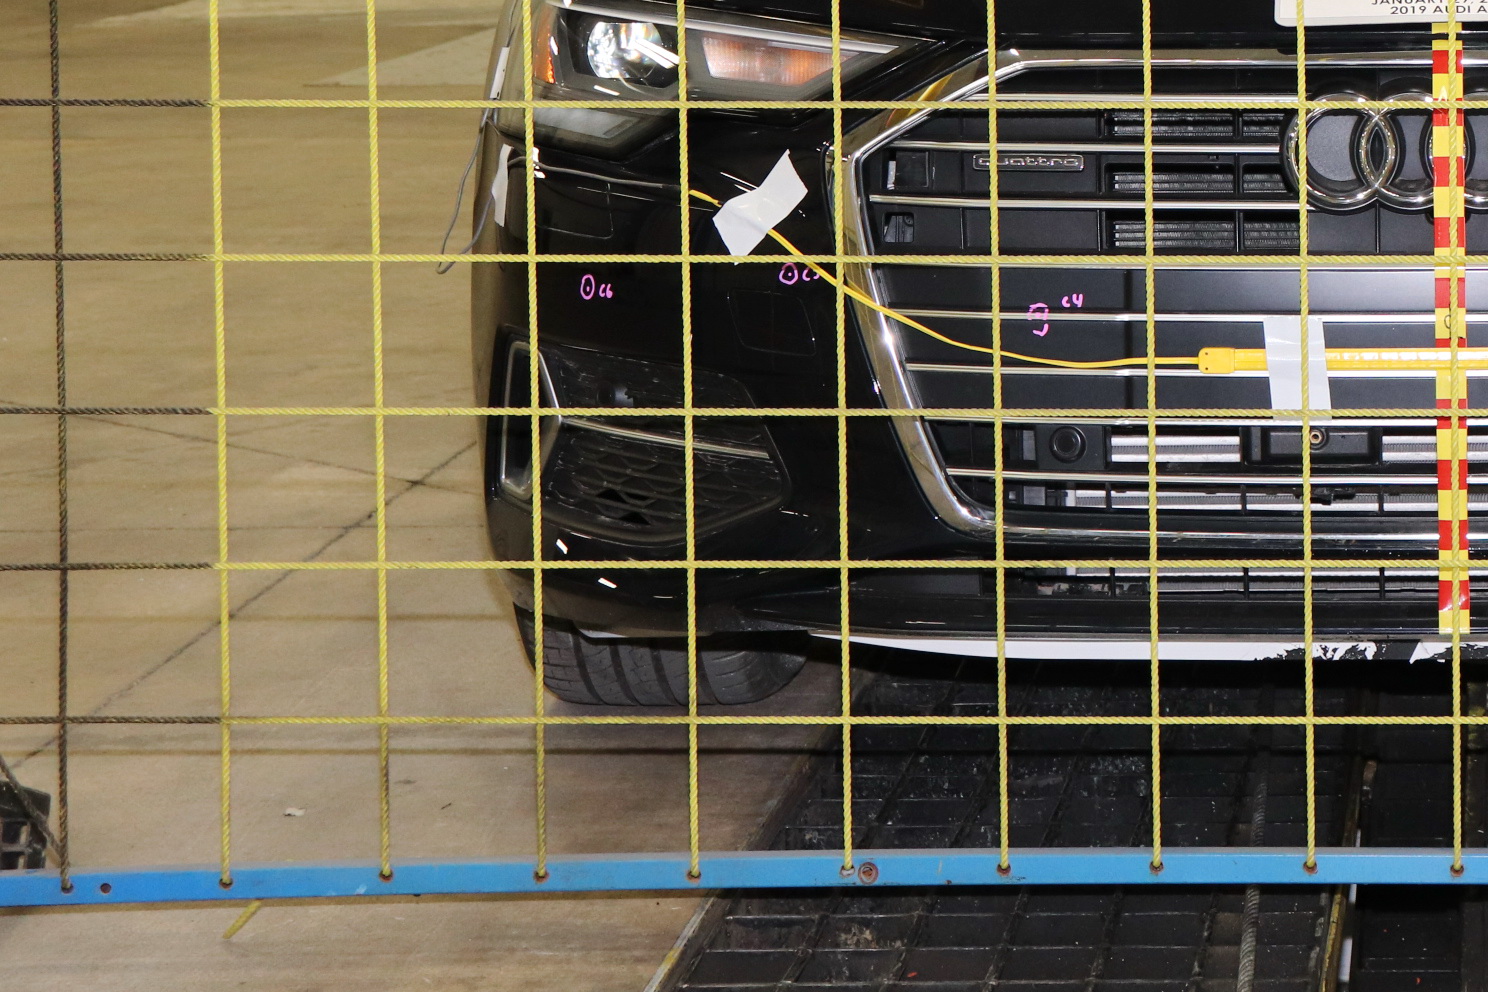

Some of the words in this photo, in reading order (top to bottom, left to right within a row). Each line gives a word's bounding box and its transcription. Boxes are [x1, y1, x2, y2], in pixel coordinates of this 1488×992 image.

[1390, 5, 1427, 15] 2019
[599, 283, 613, 298] C6
[1061, 293, 1084, 308] C4
